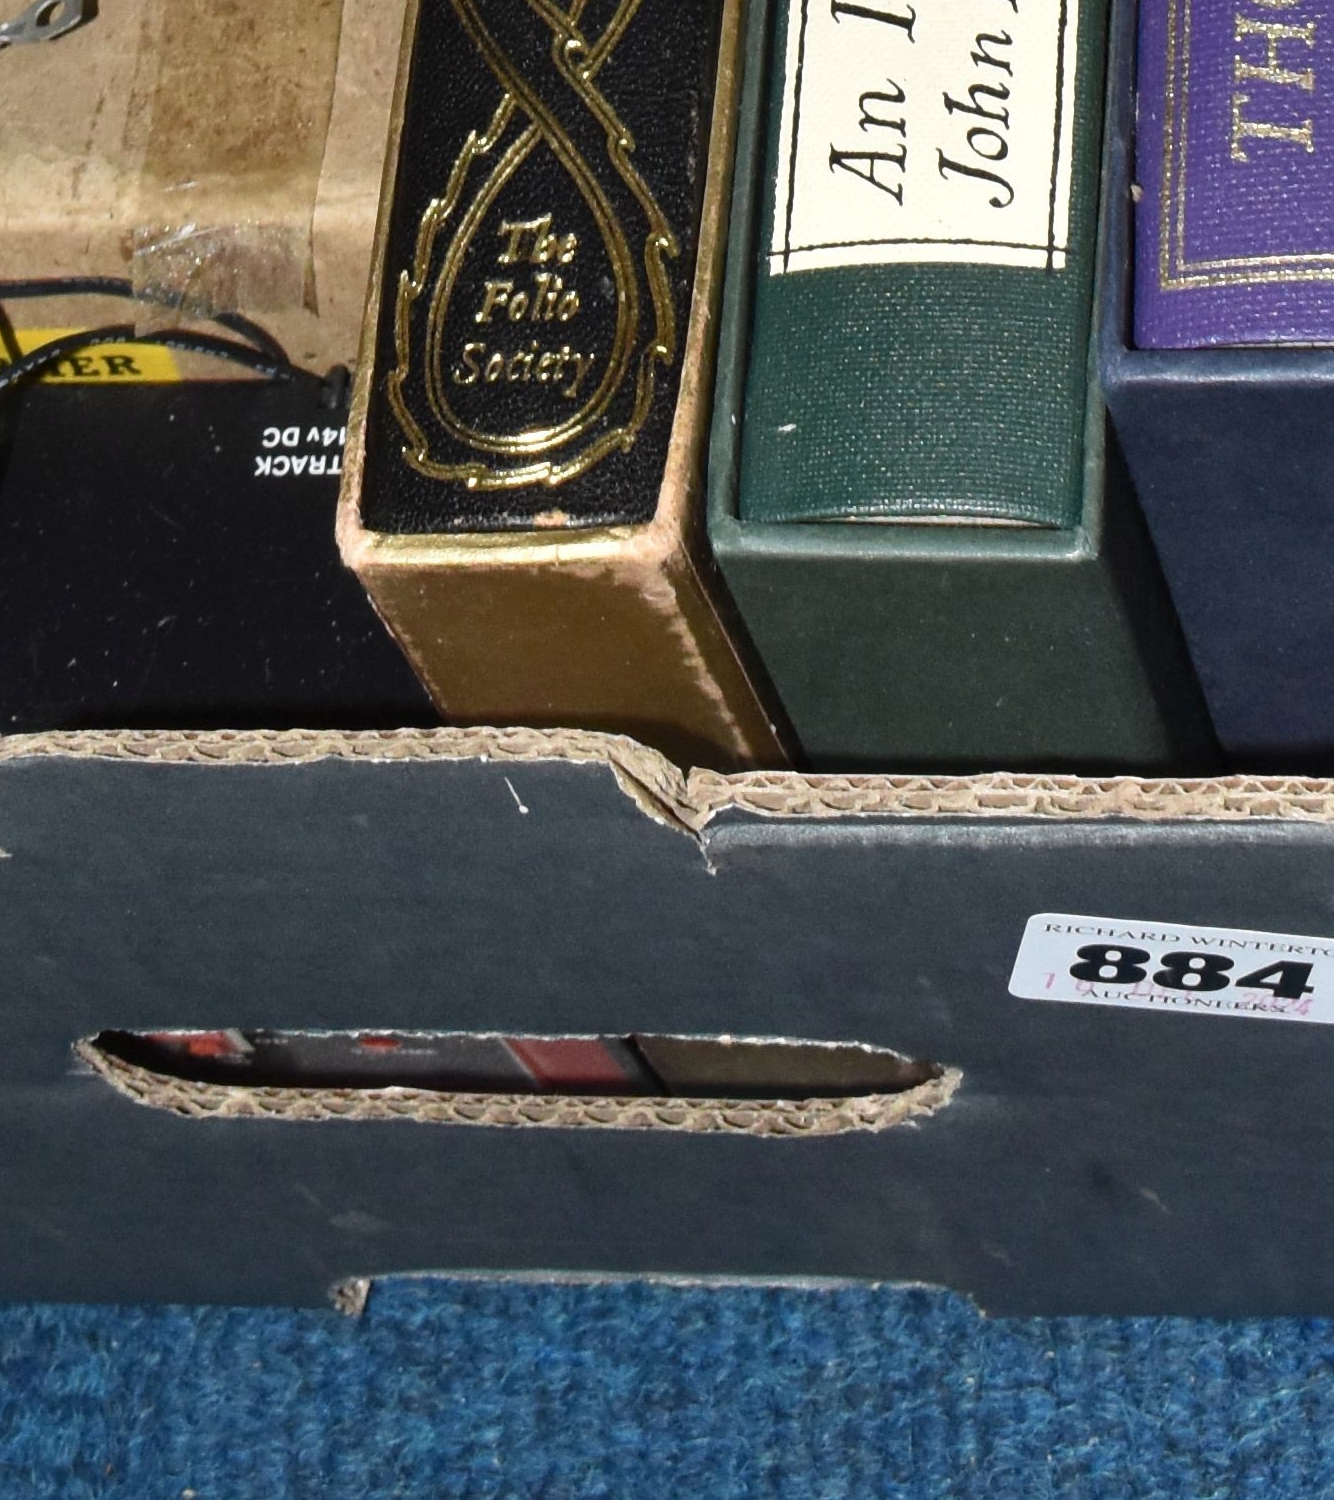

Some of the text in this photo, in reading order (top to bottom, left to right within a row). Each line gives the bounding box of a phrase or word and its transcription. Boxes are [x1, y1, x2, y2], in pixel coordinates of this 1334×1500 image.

[827, 75, 910, 206] An
[936, 28, 1017, 211] John
[496, 211, 579, 265] The
[473, 271, 581, 325] Folio
[452, 339, 597, 399] Society
[261, 426, 348, 448] 14v DC
[253, 454, 344, 478] TRACK
[1043, 921, 1181, 945] RICHARD
[1068, 943, 1316, 1001] 884
[1086, 988, 1292, 1015] AUCTIONEERS
